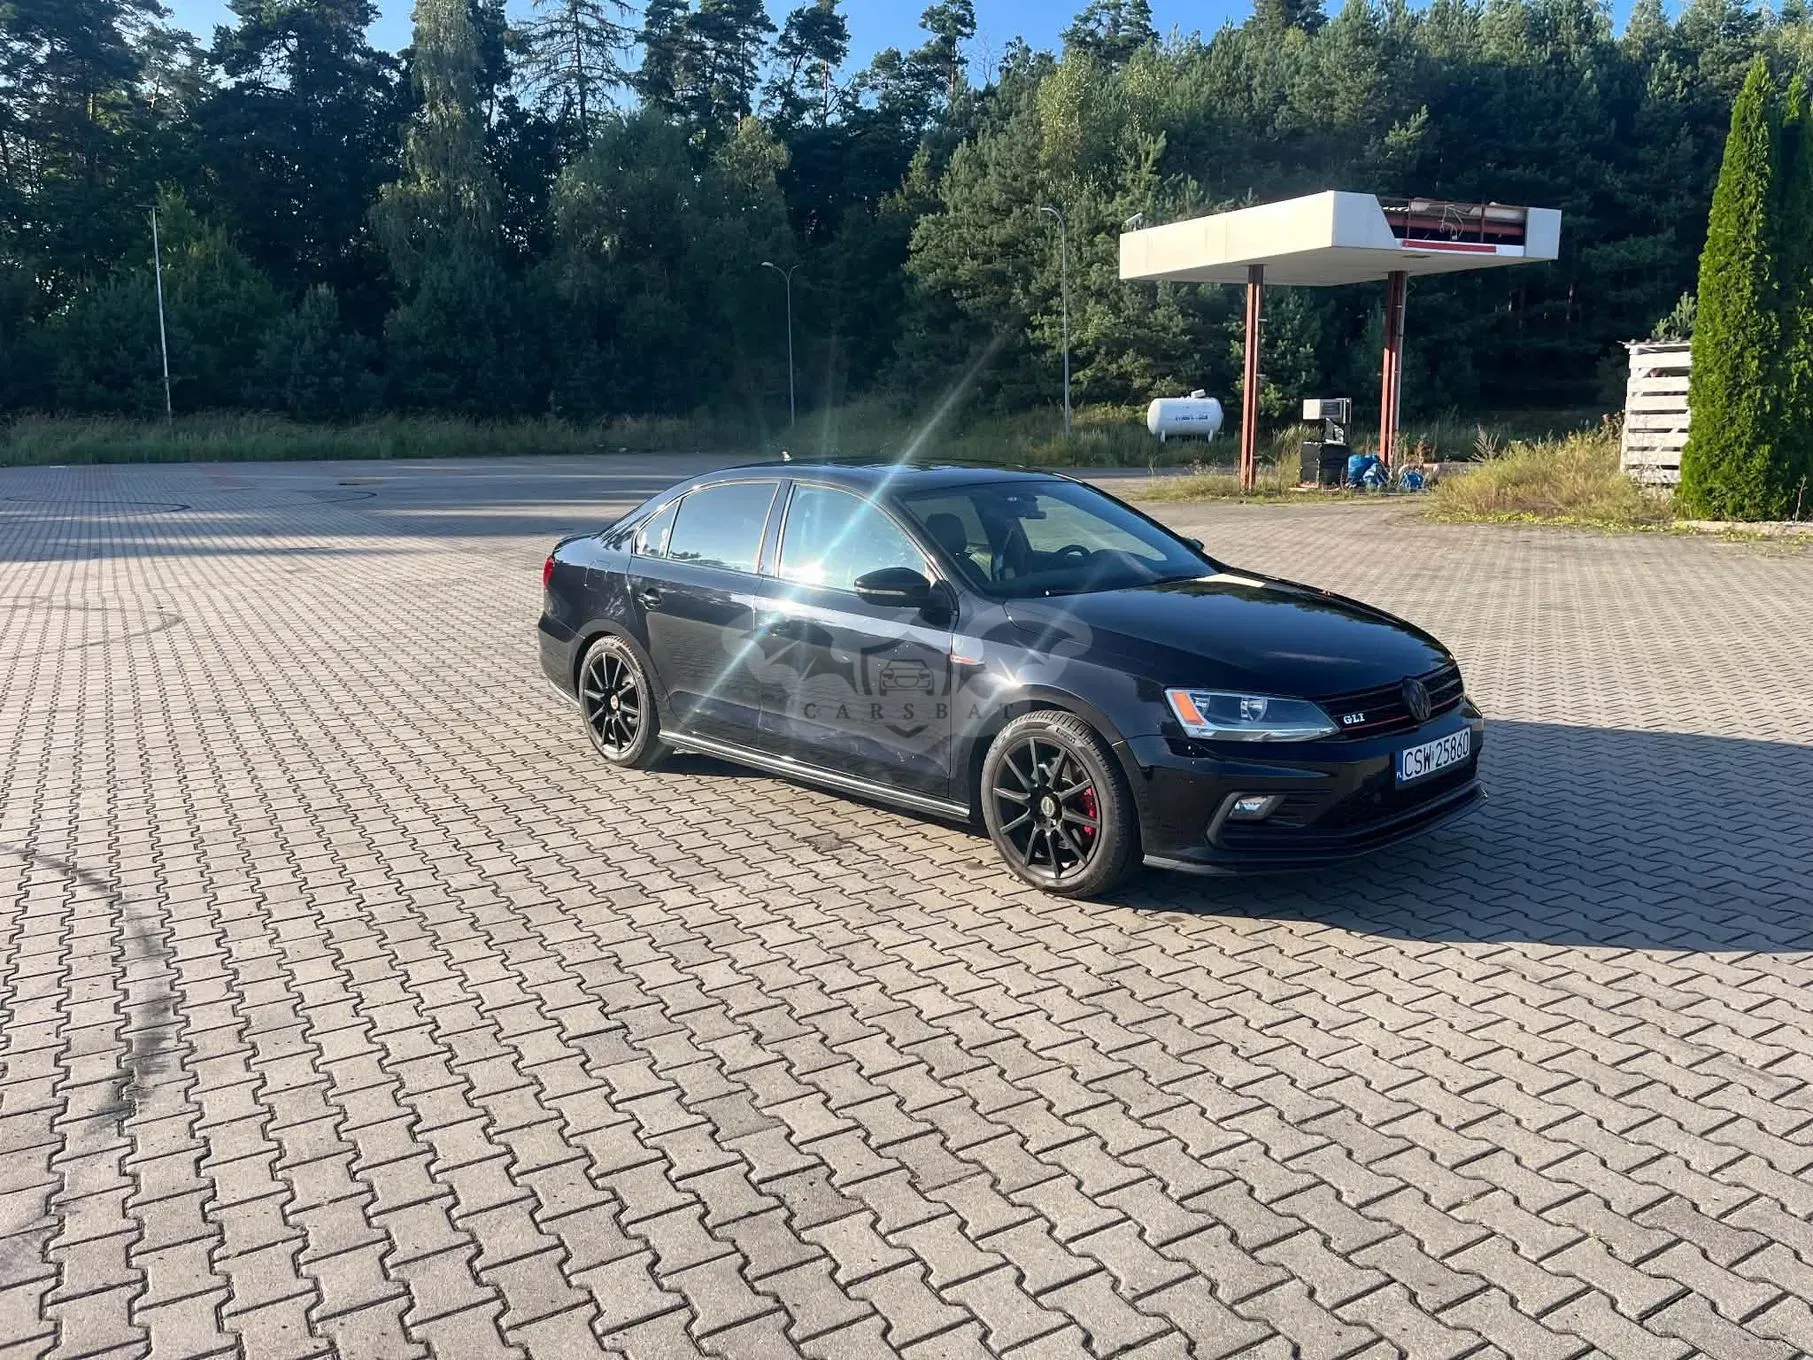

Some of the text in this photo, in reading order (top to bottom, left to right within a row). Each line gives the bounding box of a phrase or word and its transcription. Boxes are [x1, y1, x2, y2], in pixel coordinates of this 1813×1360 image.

[1343, 712, 1366, 725] GLI
[1404, 730, 1469, 778] CSW 25860
